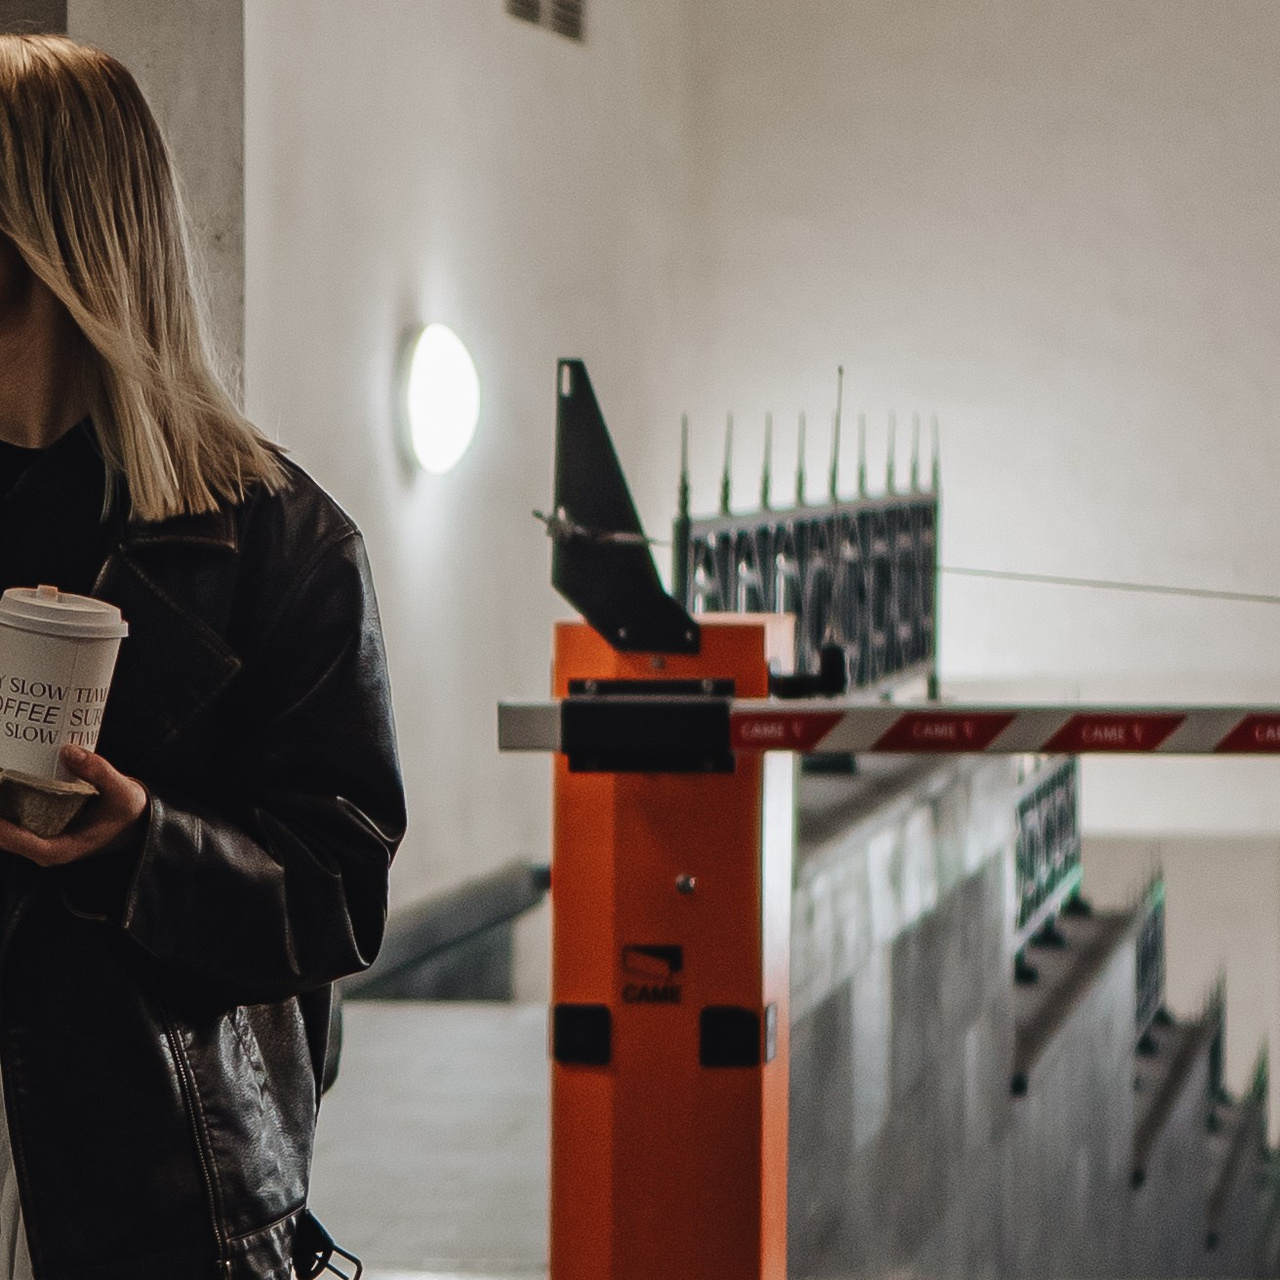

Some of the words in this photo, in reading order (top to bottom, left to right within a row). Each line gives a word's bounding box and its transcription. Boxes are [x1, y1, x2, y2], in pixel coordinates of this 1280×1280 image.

[10, 677, 70, 702] SLOW
[4, 721, 60, 745] SLOW
[1081, 723, 1126, 742] CAME
[622, 984, 682, 1004] CAME
